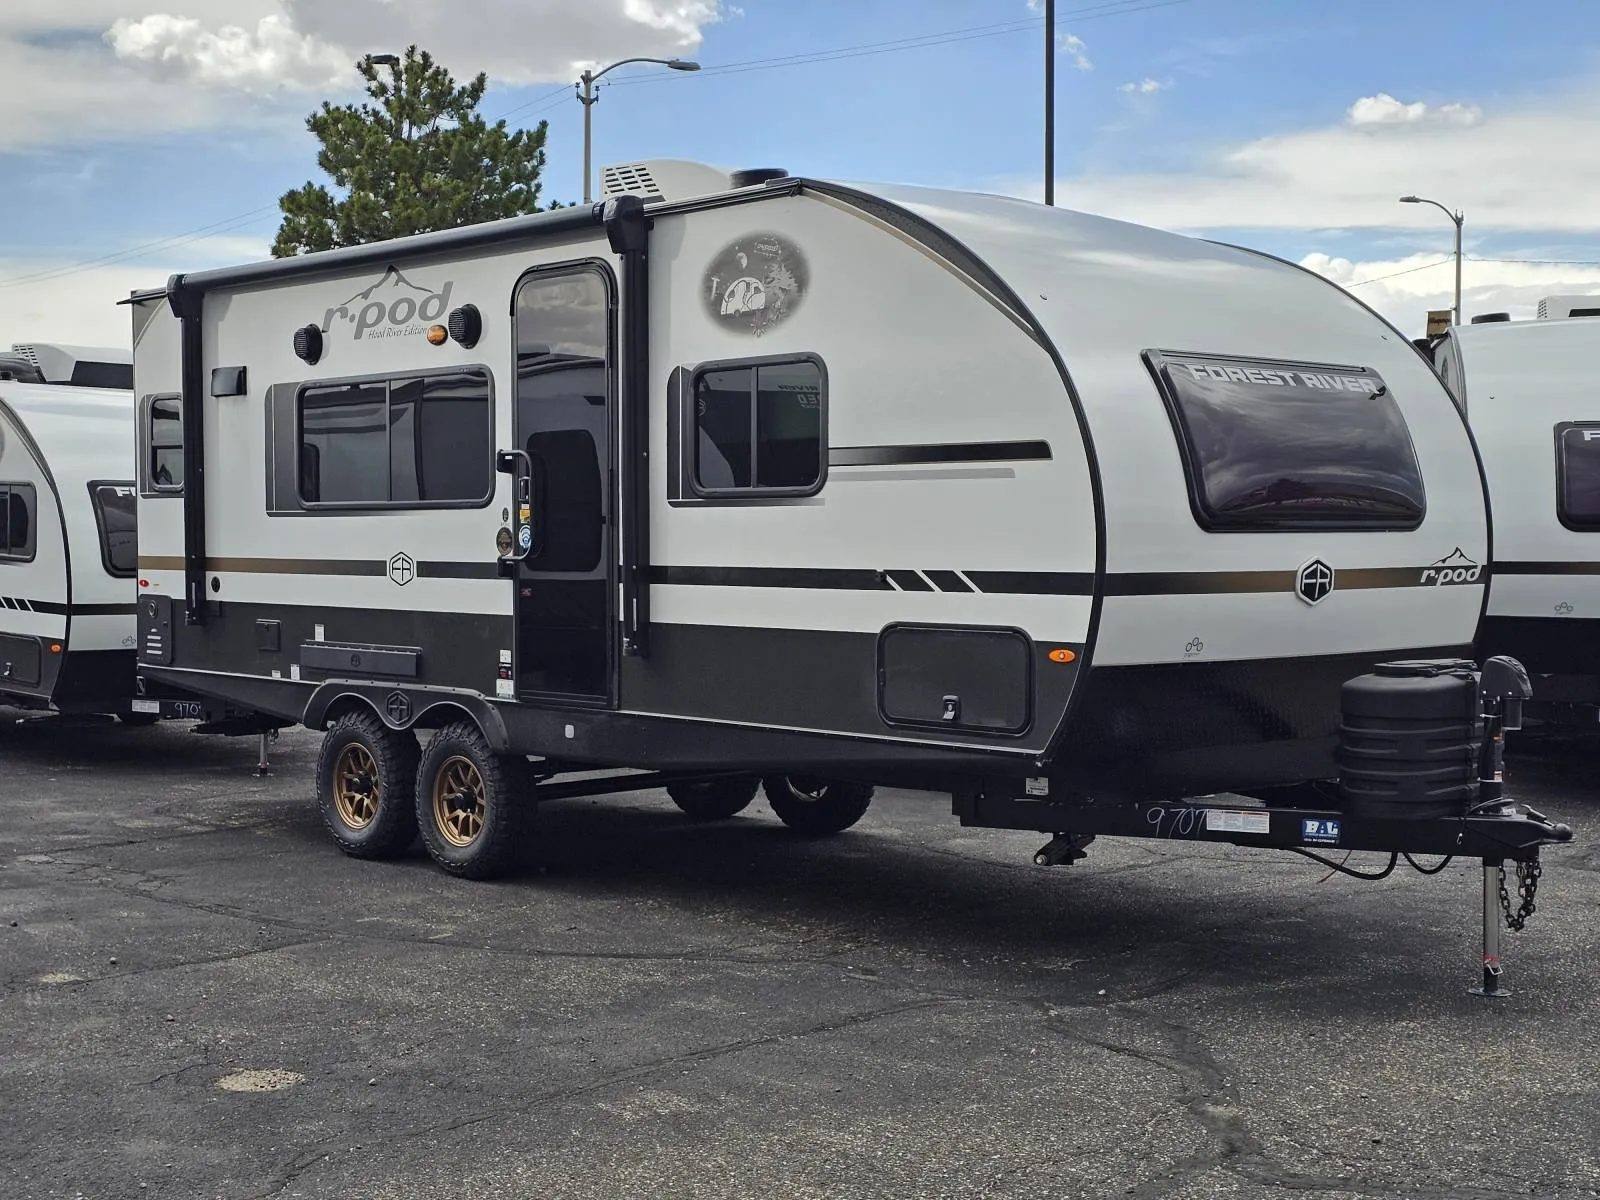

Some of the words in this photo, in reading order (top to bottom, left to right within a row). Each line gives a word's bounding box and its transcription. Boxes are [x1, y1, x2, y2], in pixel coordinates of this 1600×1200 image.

[1187, 363, 1298, 387] FOREST
[1301, 373, 1380, 395] RIVER
[174, 702, 202, 717] 970
[1147, 806, 1208, 839] 9707
